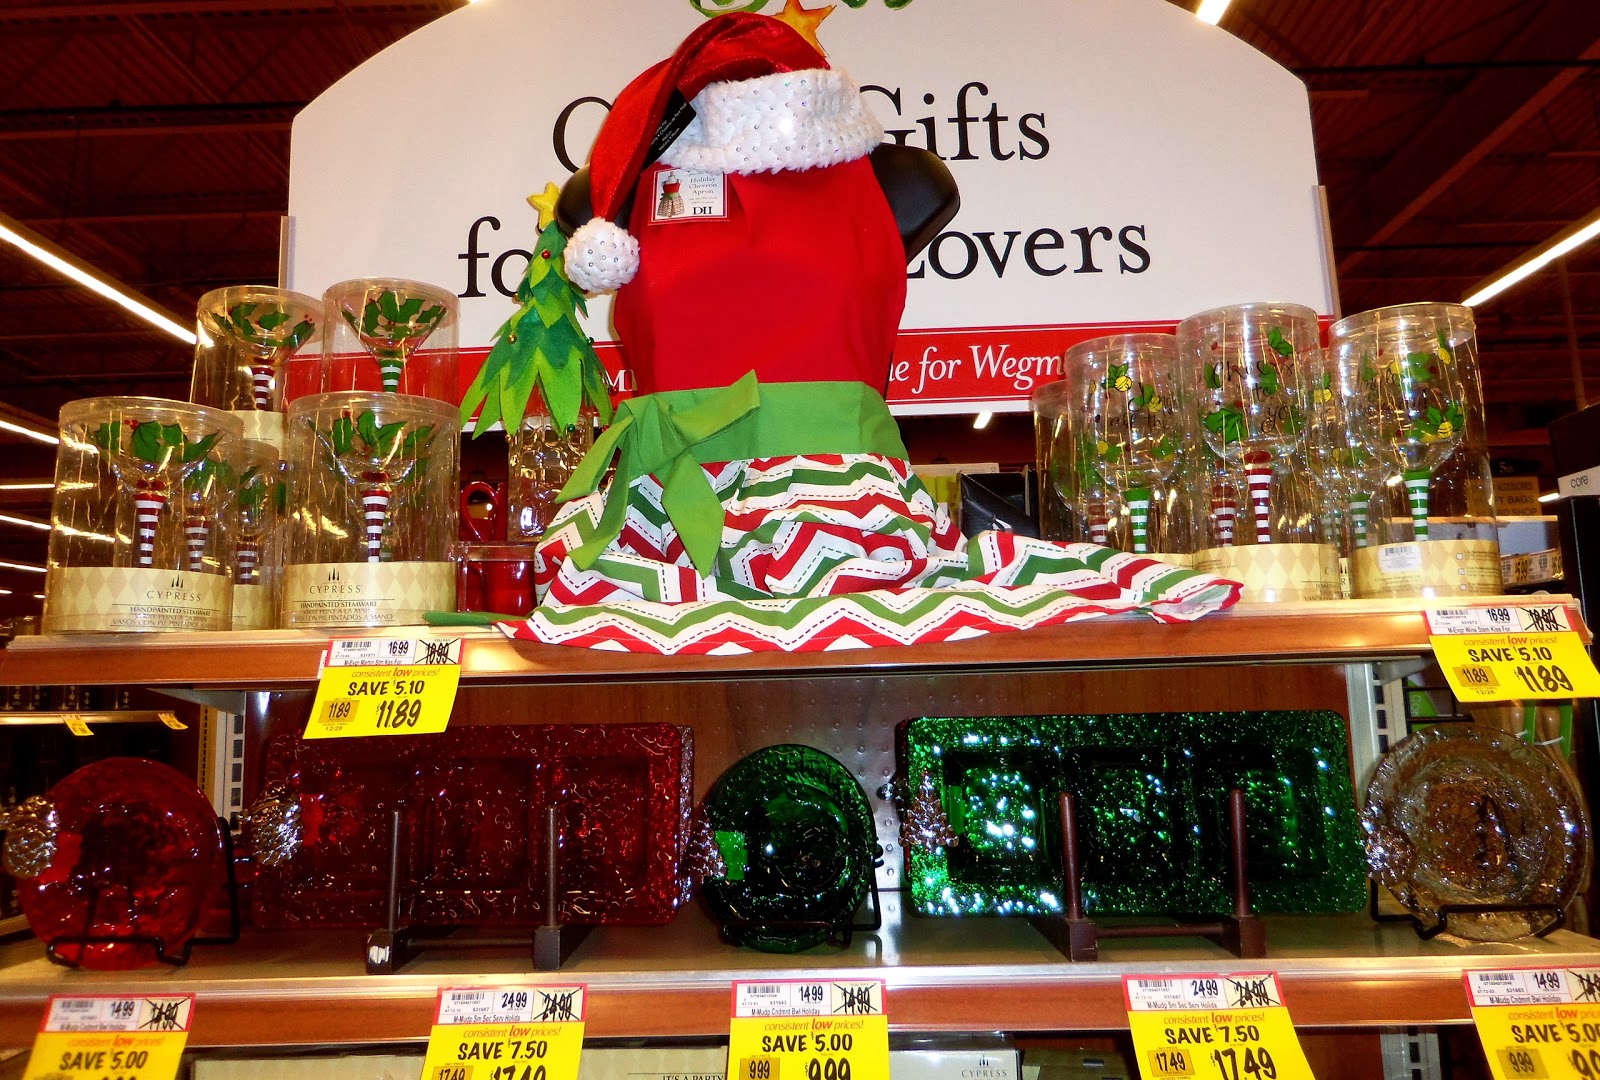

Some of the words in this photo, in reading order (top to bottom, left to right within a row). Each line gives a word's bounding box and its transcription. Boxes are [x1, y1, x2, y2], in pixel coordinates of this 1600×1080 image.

[690, 176, 715, 184] Holiday
[458, 216, 535, 298] fo
[906, 225, 1150, 280] overs
[912, 346, 961, 394] for
[969, 344, 1064, 390] Wegm
[1570, 474, 1589, 489] core
[1508, 496, 1534, 504] BAGS
[147, 591, 202, 601] CYPRESS
[310, 585, 361, 594] CYPRESS
[1463, 637, 1505, 646] consistent
[1507, 635, 1528, 644] low
[1529, 636, 1557, 646] prices!
[1468, 648, 1514, 662] SAVE
[351, 670, 392, 678] consistent
[393, 667, 412, 676] low
[412, 668, 440, 678] prices!
[348, 680, 389, 696] SAVE
[1164, 1015, 1209, 1025] consistent
[1211, 1012, 1232, 1023] low
[1235, 1013, 1265, 1023] prices!
[1509, 1011, 1554, 1020] consistent
[1555, 1007, 1578, 1019] low
[1580, 1010, 1600, 1020] pric
[764, 1021, 810, 1031] consistent
[812, 1018, 832, 1029] low
[834, 1020, 864, 1031] prices!
[463, 1028, 508, 1038] consistent
[509, 1025, 531, 1036] low
[531, 1026, 562, 1038] prices!
[1164, 1027, 1214, 1045] SAVE
[1511, 1024, 1562, 1043] SAVE
[113, 1035, 135, 1047] low
[762, 1034, 808, 1052] SAVE
[810, 1032, 853, 1051] $5.00
[458, 1041, 504, 1060] SAVE
[507, 1039, 548, 1059] $7.50
[59, 1052, 107, 1070] SAVE
[962, 1070, 1007, 1078] CYPRESS
